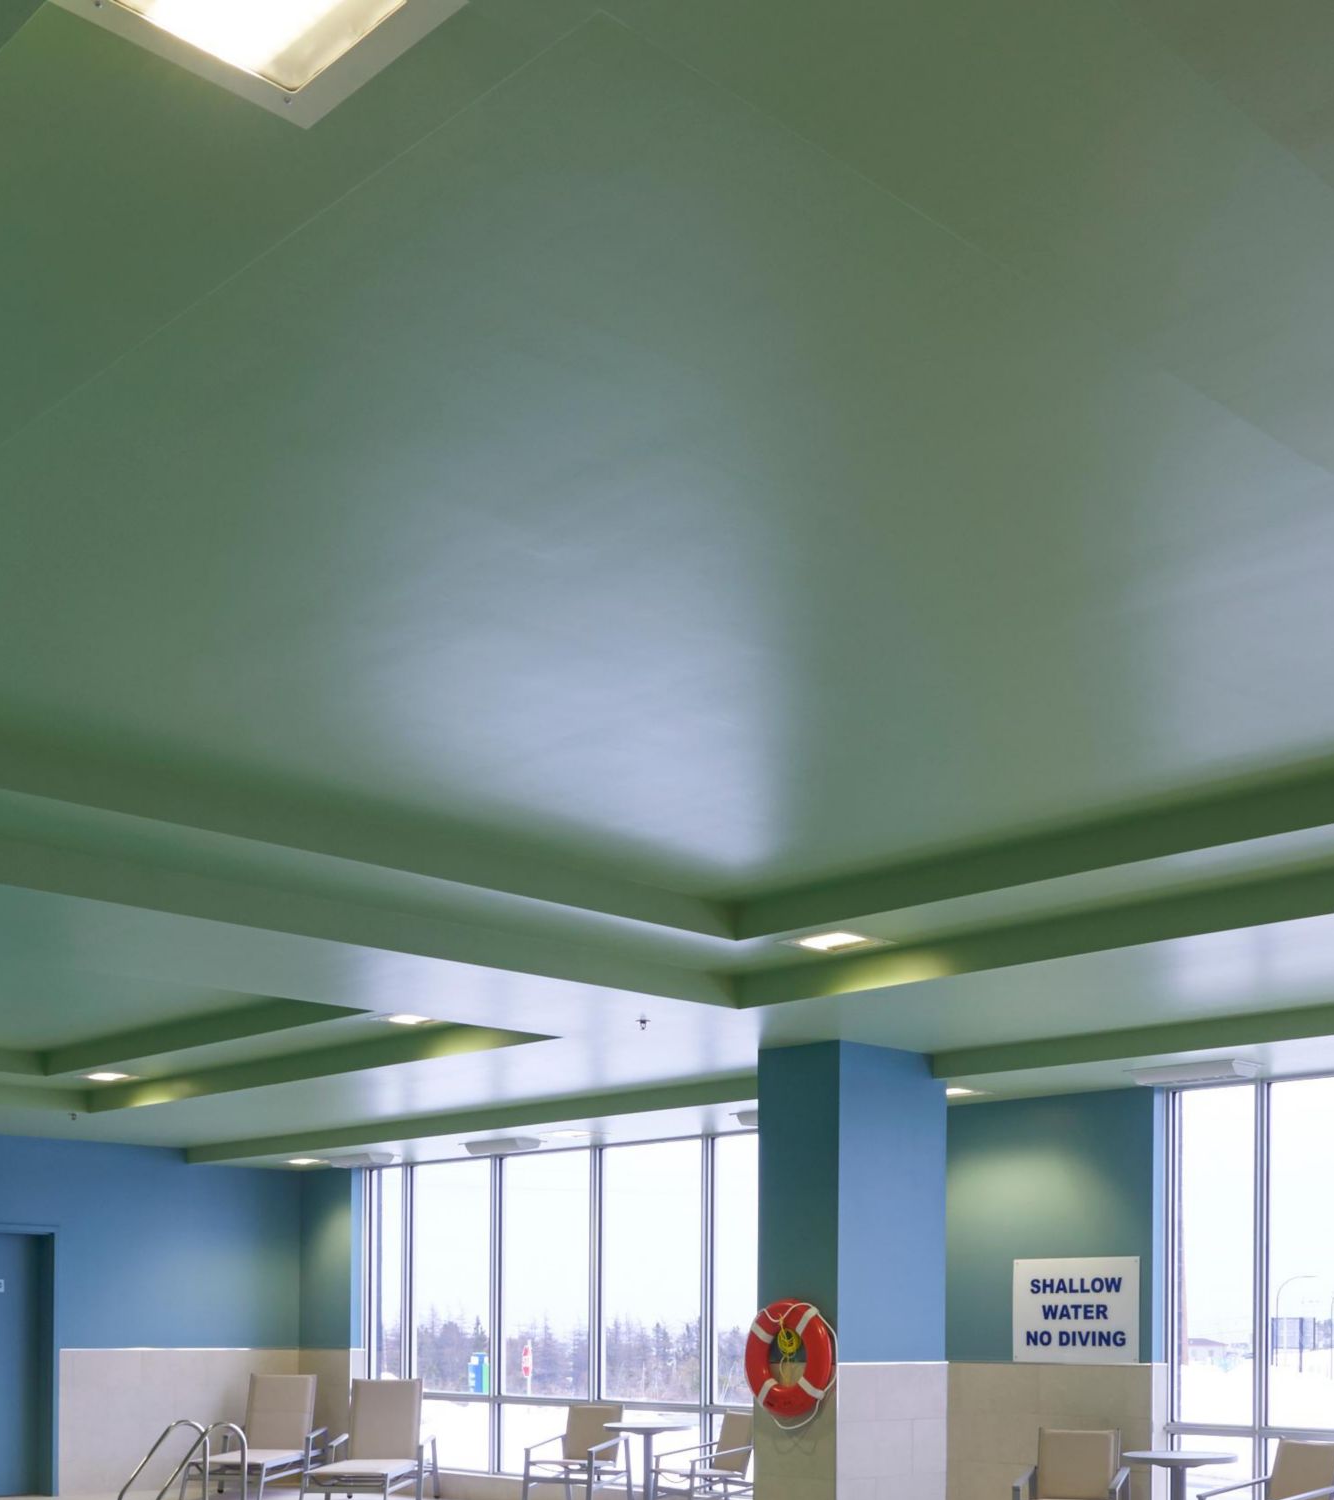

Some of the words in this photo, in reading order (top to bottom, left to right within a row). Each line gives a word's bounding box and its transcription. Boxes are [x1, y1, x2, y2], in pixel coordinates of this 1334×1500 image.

[1030, 1277, 1122, 1294] SHALLOW
[1042, 1304, 1108, 1320] WATER
[1026, 1331, 1052, 1346] NO
[1058, 1331, 1126, 1347] DIVING
